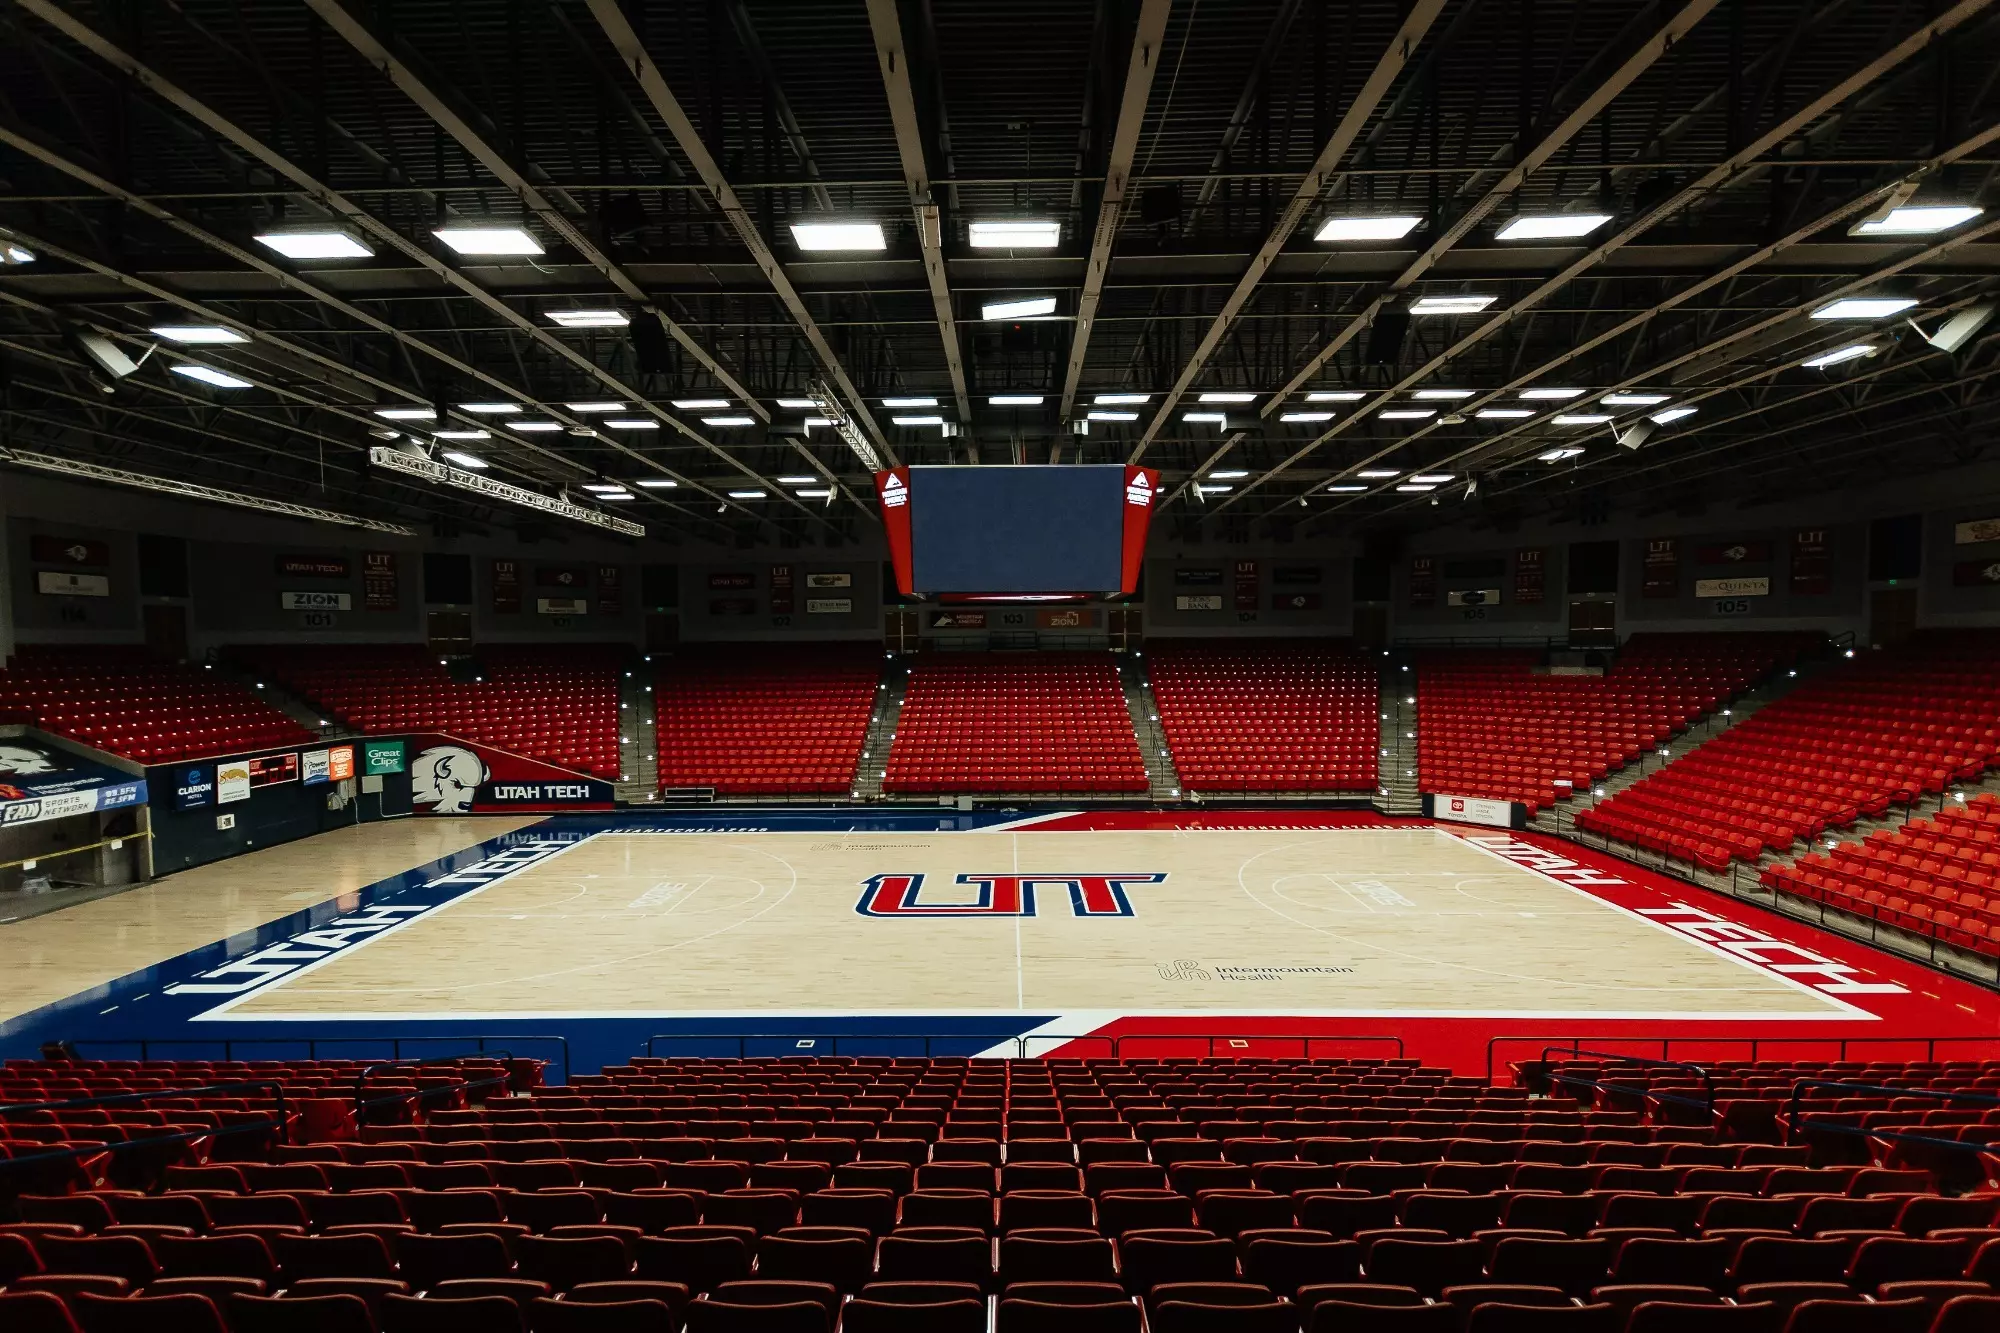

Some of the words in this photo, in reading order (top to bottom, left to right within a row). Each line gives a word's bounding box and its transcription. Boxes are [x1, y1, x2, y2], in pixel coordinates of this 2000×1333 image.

[316, 564, 343, 573] TECH
[294, 593, 339, 605] ZION
[1715, 601, 1748, 613] 105
[305, 614, 332, 626] 101
[1003, 614, 1024, 625] 103
[1237, 612, 1257, 622] 104
[1461, 609, 1486, 620] 105
[368, 749, 401, 758] Great
[371, 757, 400, 767] Clips
[178, 783, 212, 796] CLARION
[495, 786, 540, 799] UTAH
[544, 786, 590, 798] TECH
[45, 796, 80, 808] SPORTS
[4, 802, 40, 822] FAN
[44, 802, 90, 816] NETWORK
[854, 871, 1172, 919] UT
[163, 905, 431, 996] UTAH
[422, 839, 578, 889] TECH
[1467, 836, 1629, 885] UTAH
[1635, 901, 1913, 994] TECH
[1214, 966, 1354, 974] Intermountain
[1219, 973, 1283, 981] Health
